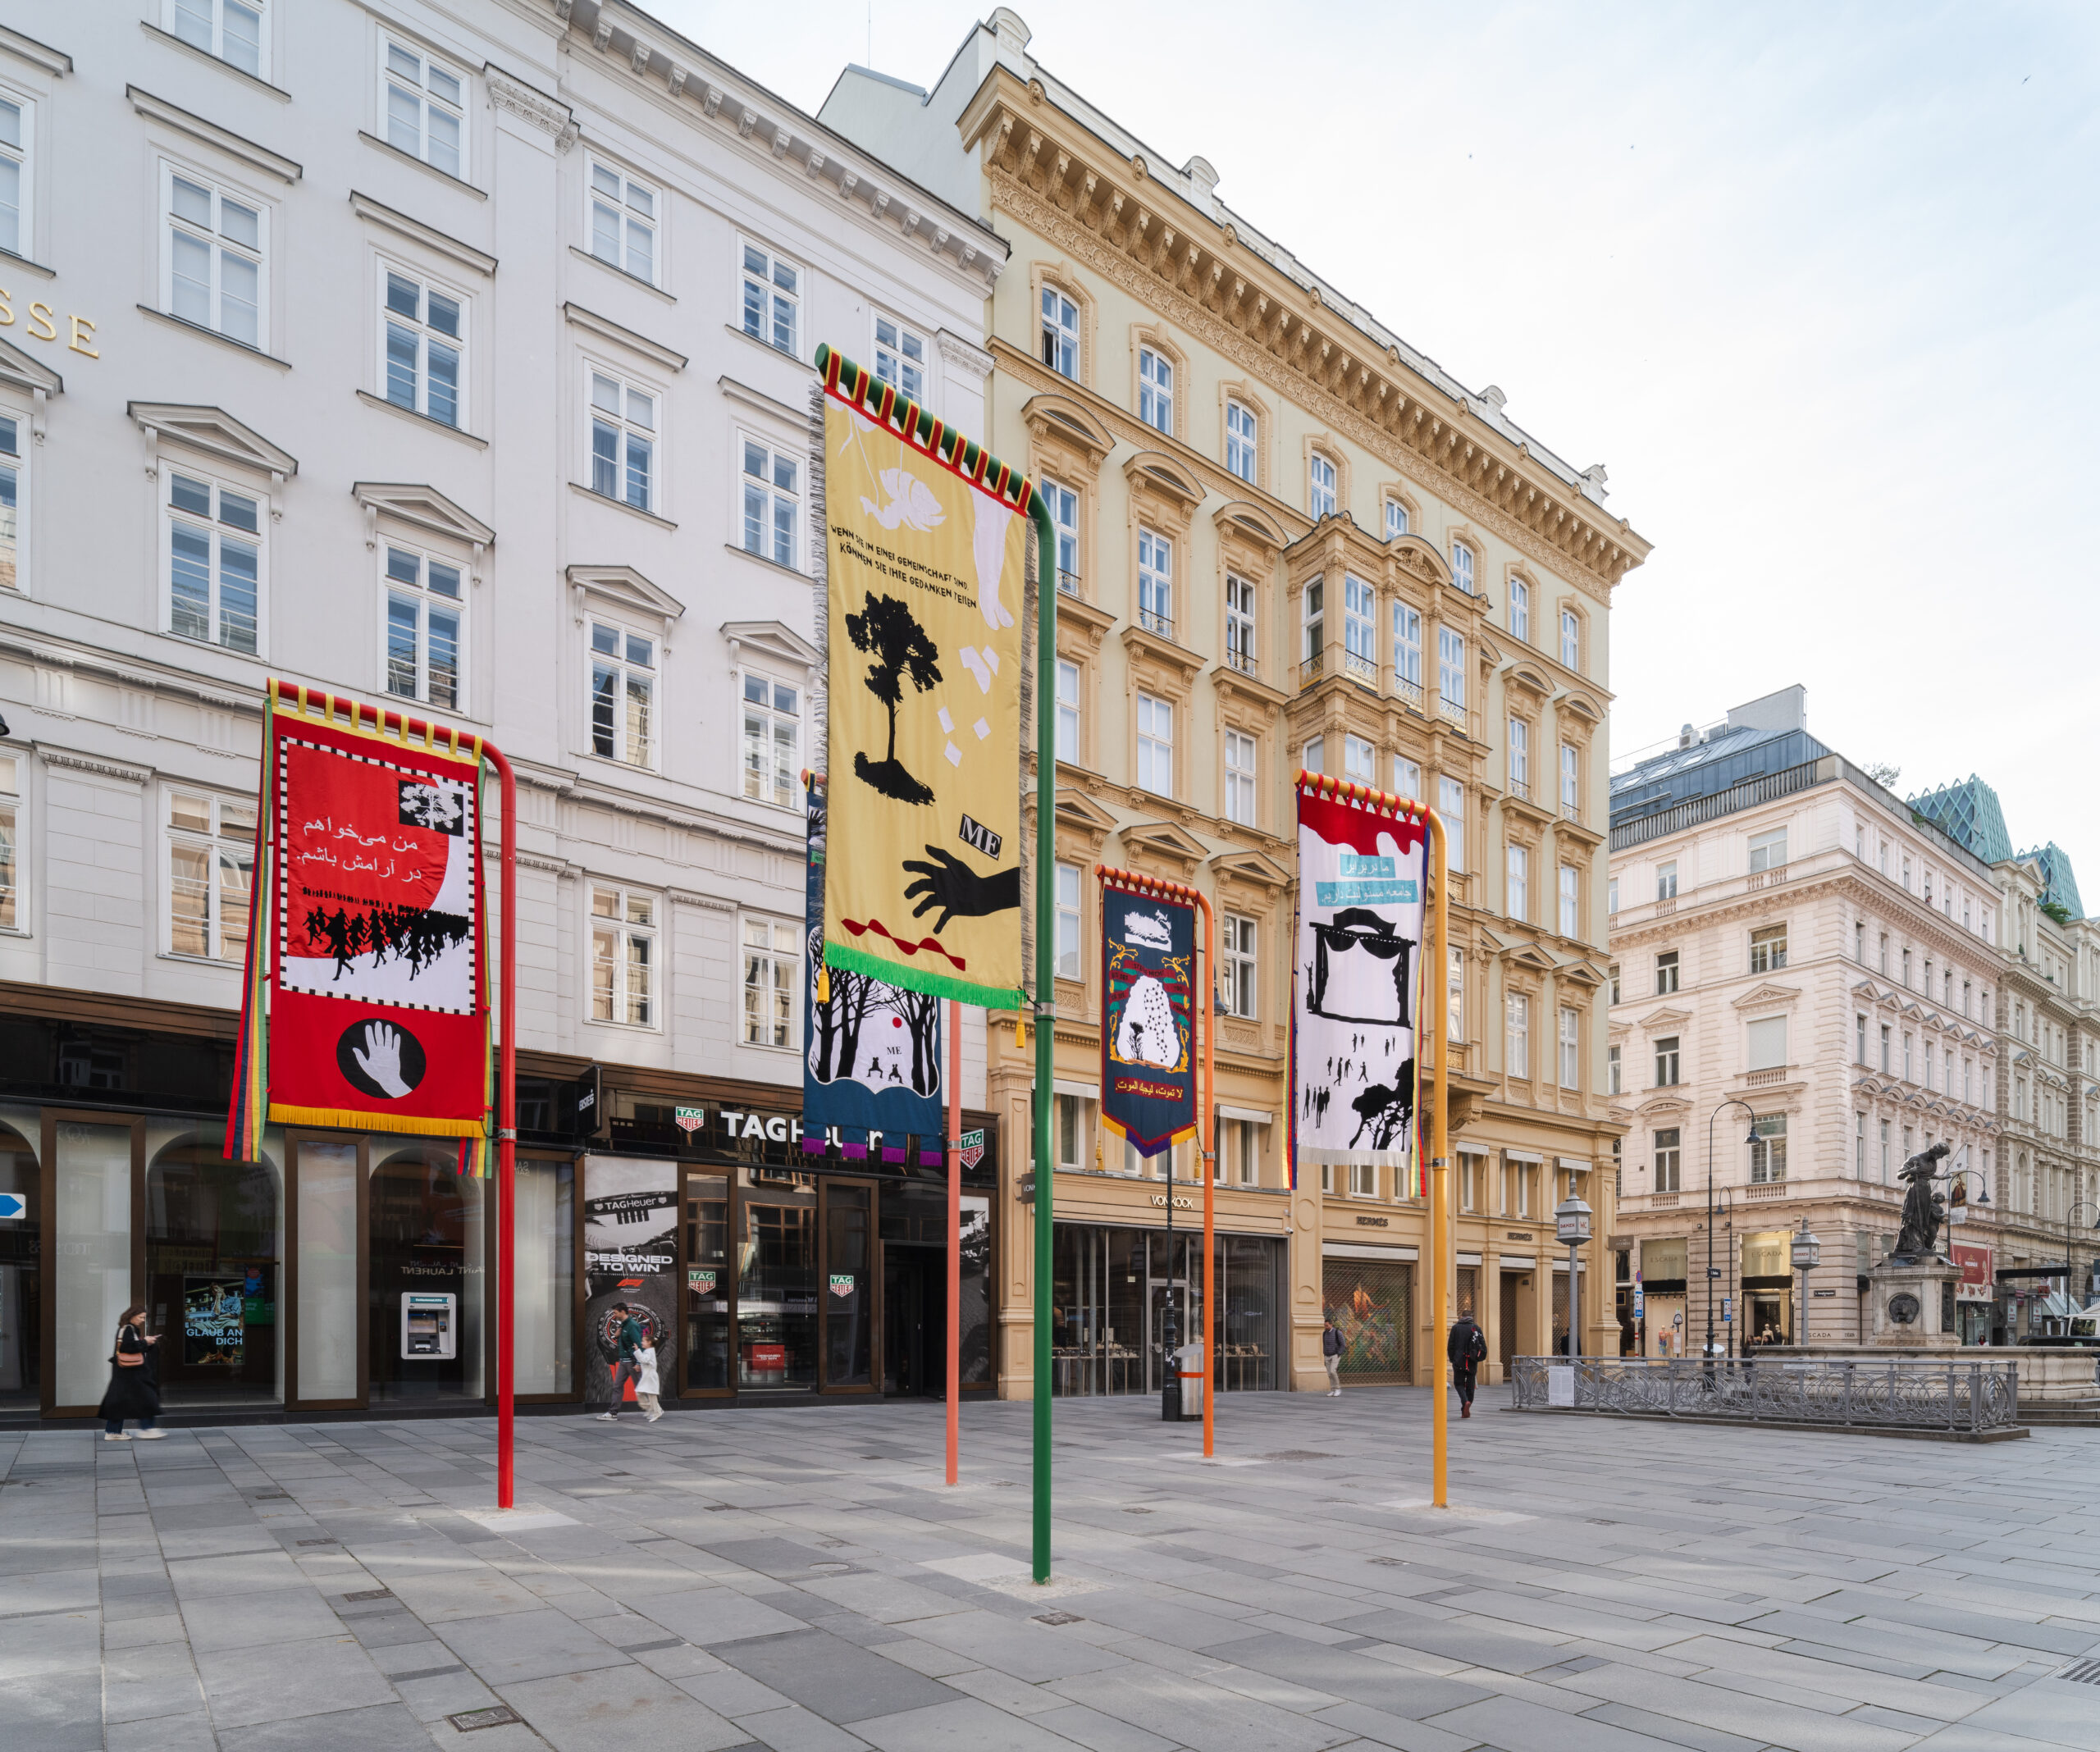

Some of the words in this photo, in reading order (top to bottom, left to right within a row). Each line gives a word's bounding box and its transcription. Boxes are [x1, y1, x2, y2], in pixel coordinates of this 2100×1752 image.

[830, 525, 854, 540] WENN
[856, 535, 864, 549] SIE
[865, 542, 874, 552] IN
[897, 556, 952, 582] GEMEINSCHAFT
[840, 541, 873, 568] KÖNNEN
[875, 560, 887, 575] SIE
[889, 567, 907, 582] IHRE
[909, 576, 952, 598] GEDANKEN
[954, 591, 977, 609] TEILEN
[959, 814, 1001, 860] ME
[392, 836, 418, 852] من
[296, 846, 337, 867] باشم.
[342, 855, 395, 878] آرامش
[401, 869, 422, 883] در
[887, 1046, 902, 1056] ME
[1176, 1088, 1183, 1098] لا
[678, 1108, 702, 1117] TAG
[677, 1117, 702, 1130] HEUER
[961, 1133, 982, 1147] TAG
[961, 1147, 983, 1165] HEUER
[605, 1198, 656, 1211] TAGHeuer
[1580, 1220, 1587, 1229] WC
[586, 1252, 673, 1265] DESIGNED
[1751, 1250, 1783, 1258] ESCADA
[600, 1262, 624, 1272] TO
[628, 1264, 660, 1272] WIN
[692, 1272, 713, 1280] TAG
[690, 1280, 714, 1293] HEUER
[830, 1284, 853, 1295] HEUER
[186, 1328, 224, 1337] GLAUB
[226, 1329, 243, 1337] AN
[216, 1337, 243, 1345] DICH
